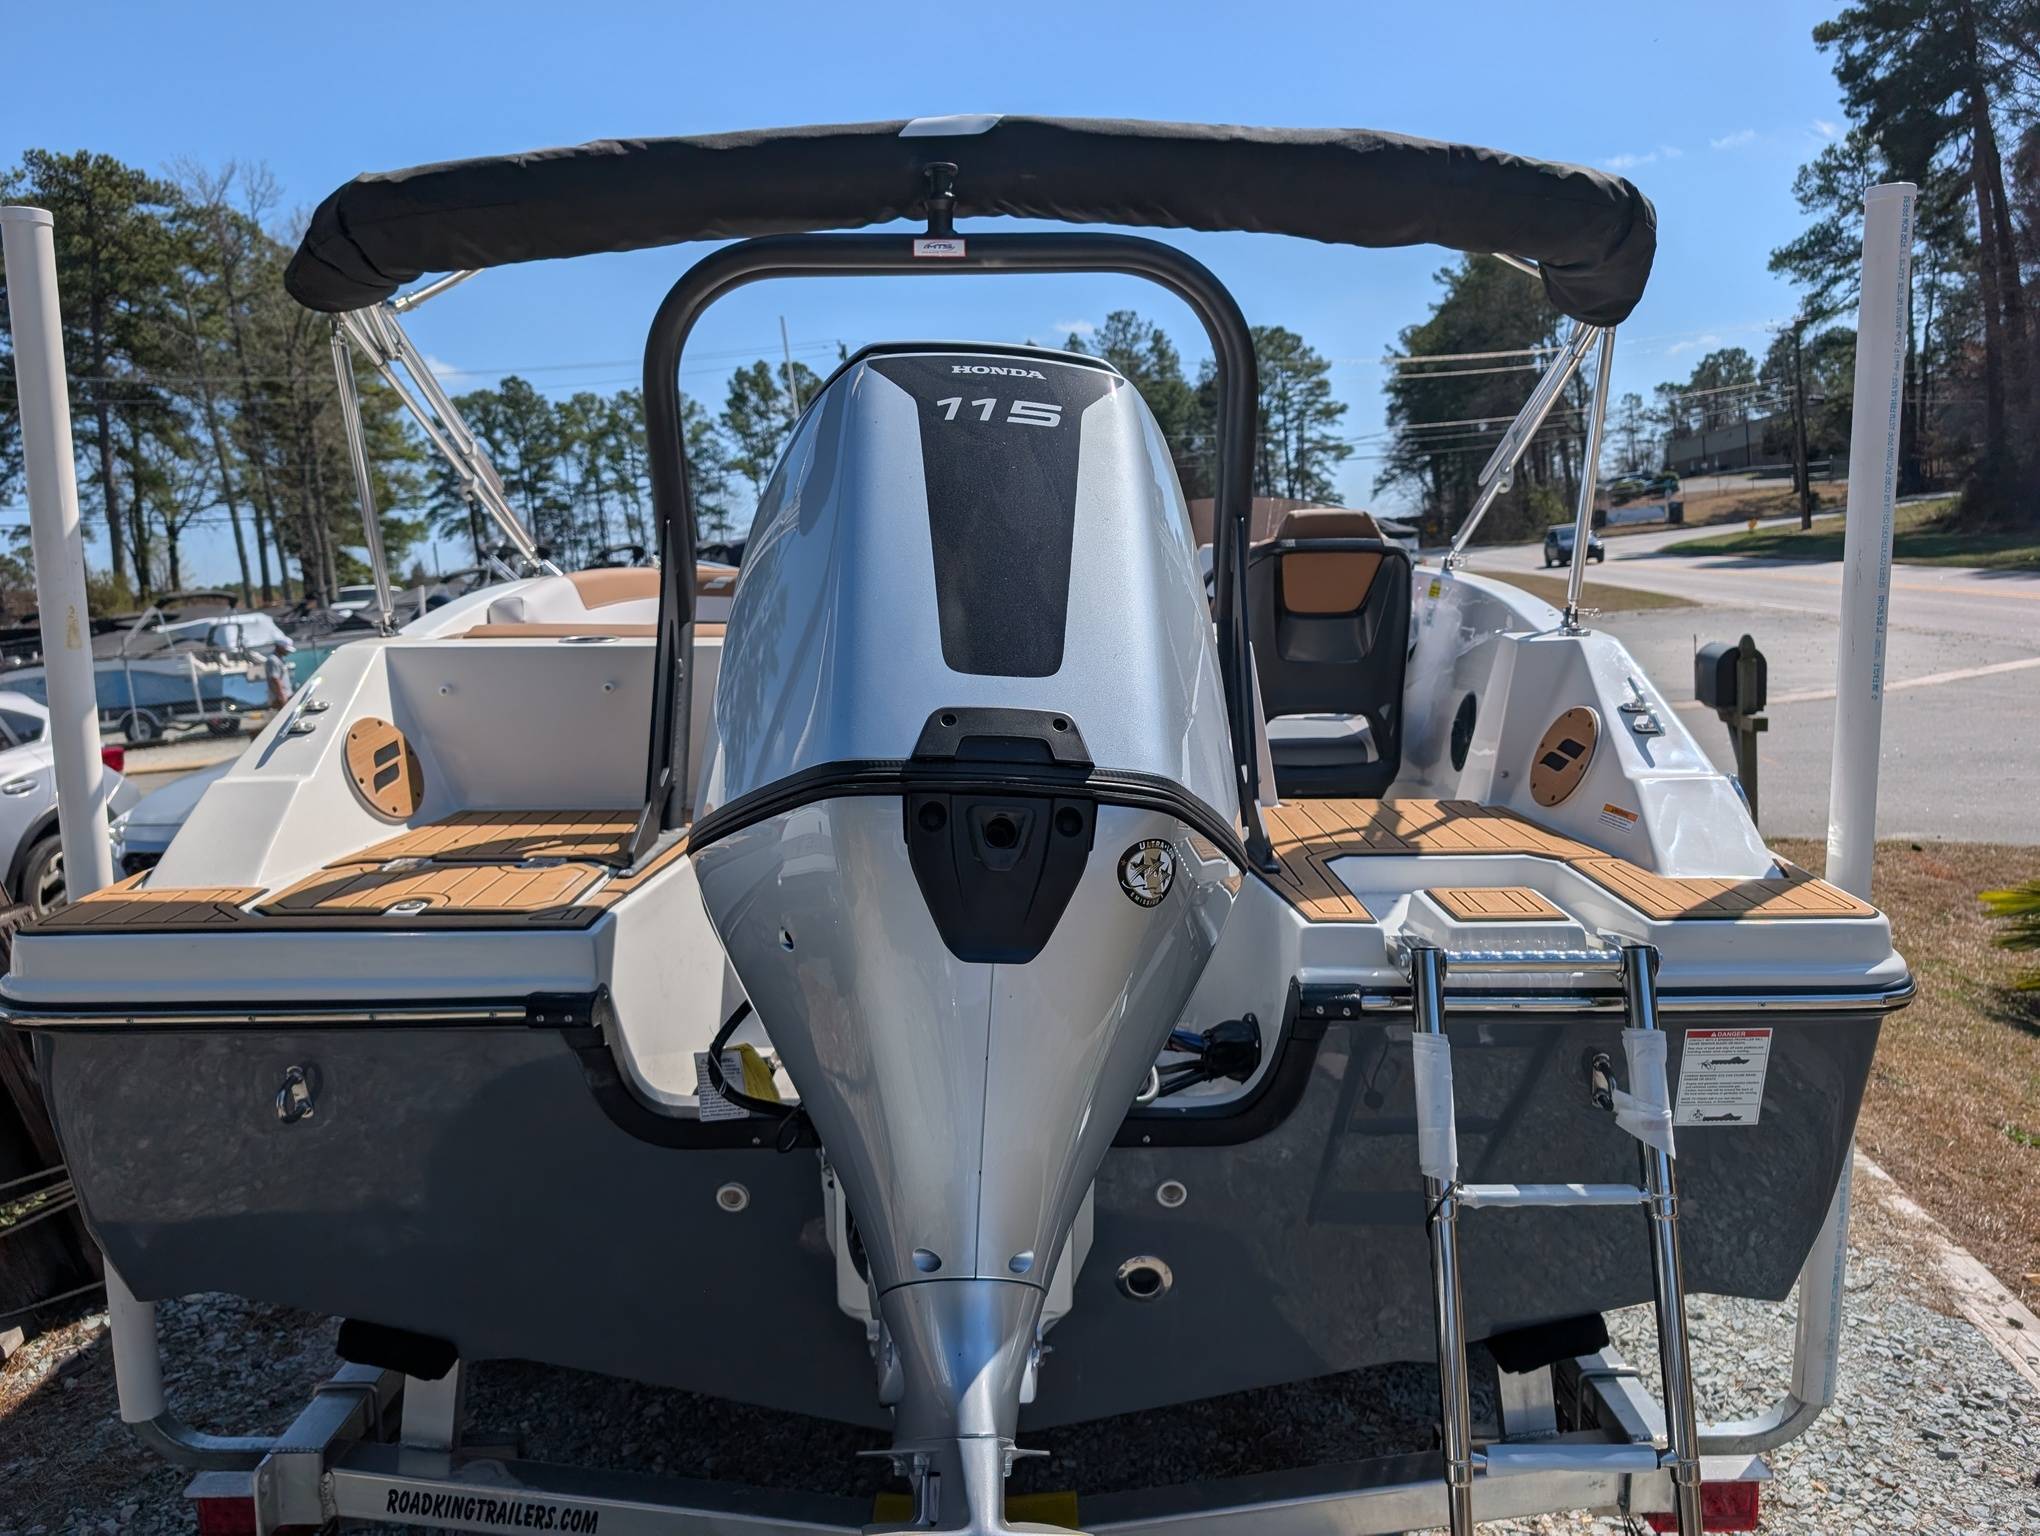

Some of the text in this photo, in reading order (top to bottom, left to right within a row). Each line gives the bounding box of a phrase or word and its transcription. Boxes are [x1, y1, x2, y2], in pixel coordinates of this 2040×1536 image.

[952, 365, 1047, 380] HONDA
[936, 397, 1063, 428] 115
[386, 1488, 600, 1534] ROADKINGTRAILERS.COM
